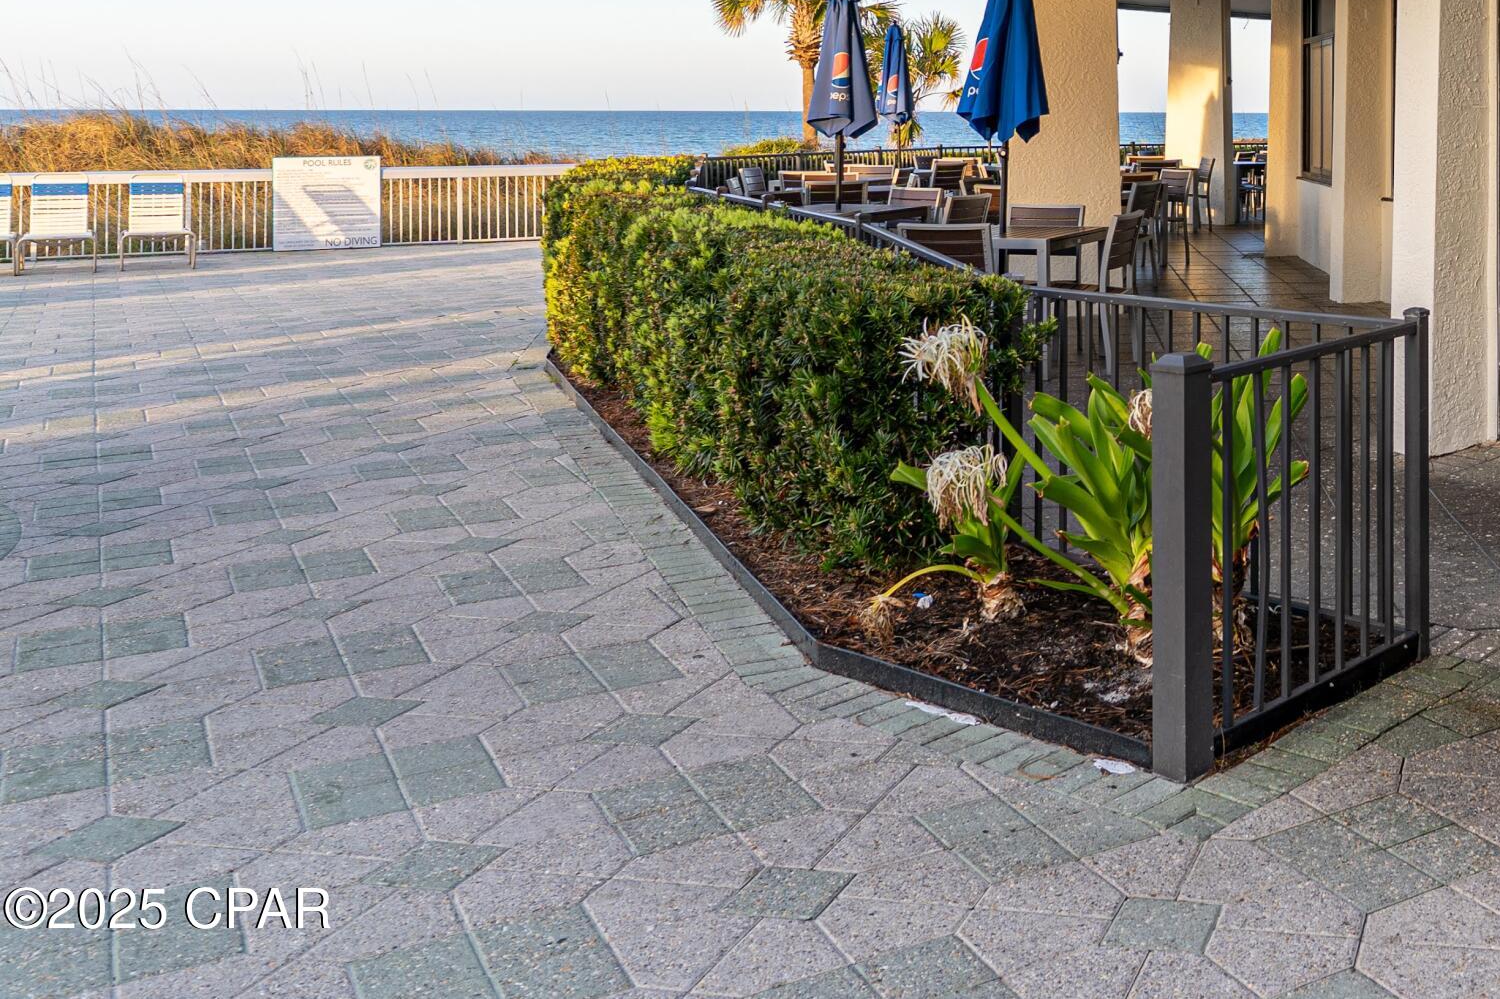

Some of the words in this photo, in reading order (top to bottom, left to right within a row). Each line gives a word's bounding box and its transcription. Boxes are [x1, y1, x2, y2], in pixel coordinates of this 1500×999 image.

[302, 159, 326, 167] POOL
[328, 158, 352, 166] RULES
[325, 238, 342, 247] NO
[344, 236, 378, 246] DIVING
